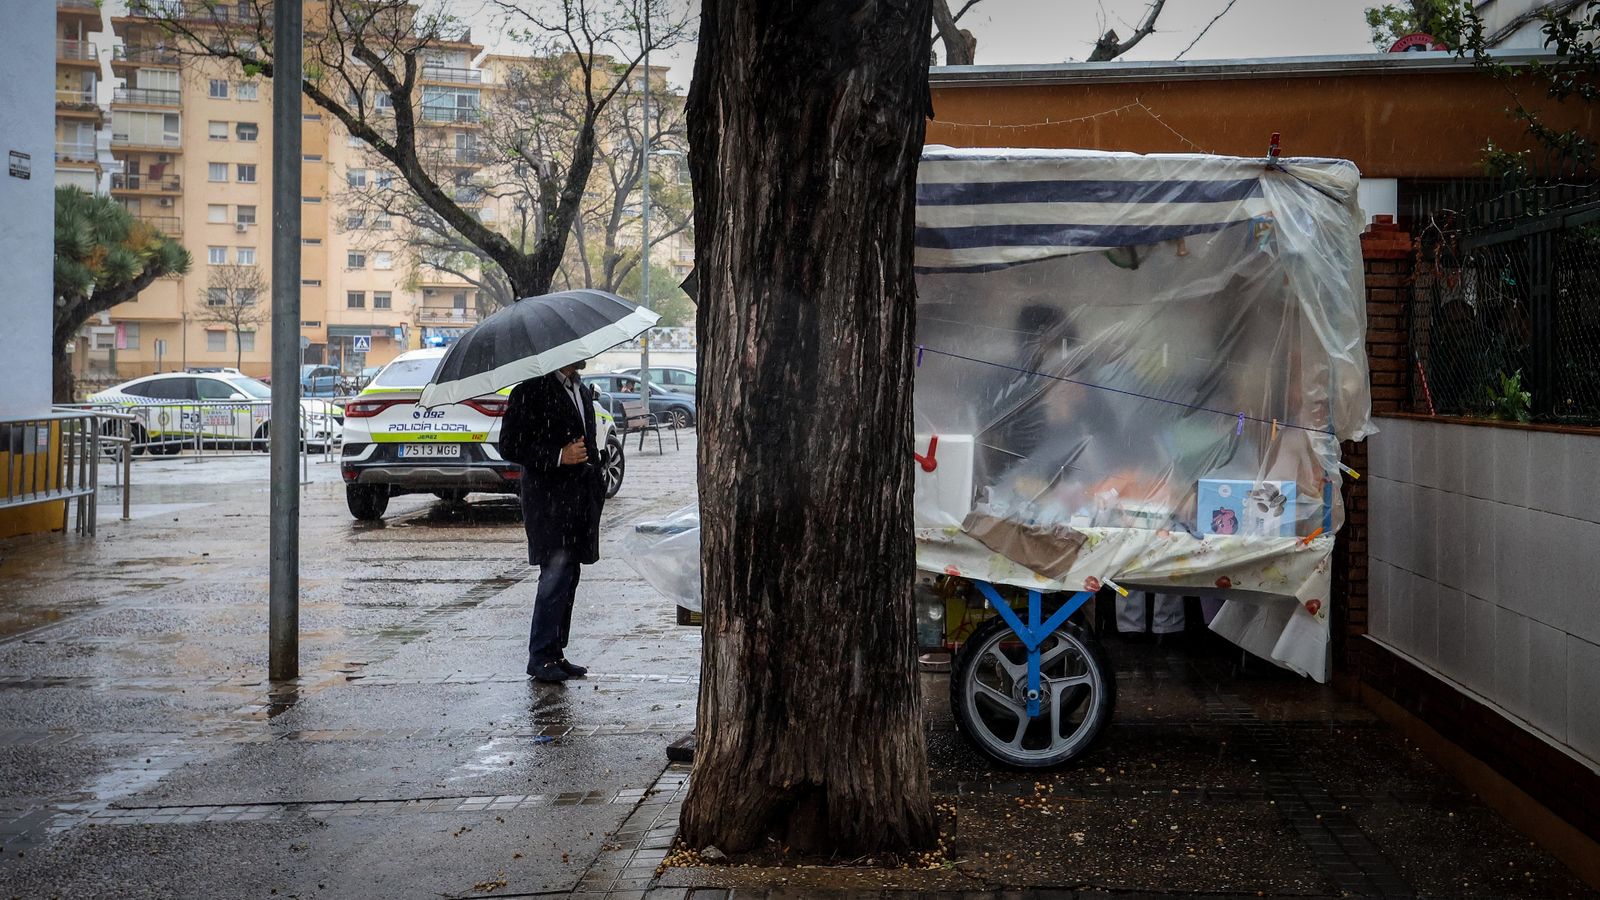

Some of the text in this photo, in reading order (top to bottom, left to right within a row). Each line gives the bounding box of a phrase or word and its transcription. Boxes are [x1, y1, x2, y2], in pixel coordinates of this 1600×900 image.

[423, 411, 445, 419] 092
[388, 421, 471, 432] POLICÍA LOCAL
[405, 445, 458, 456] 7513 MGG
